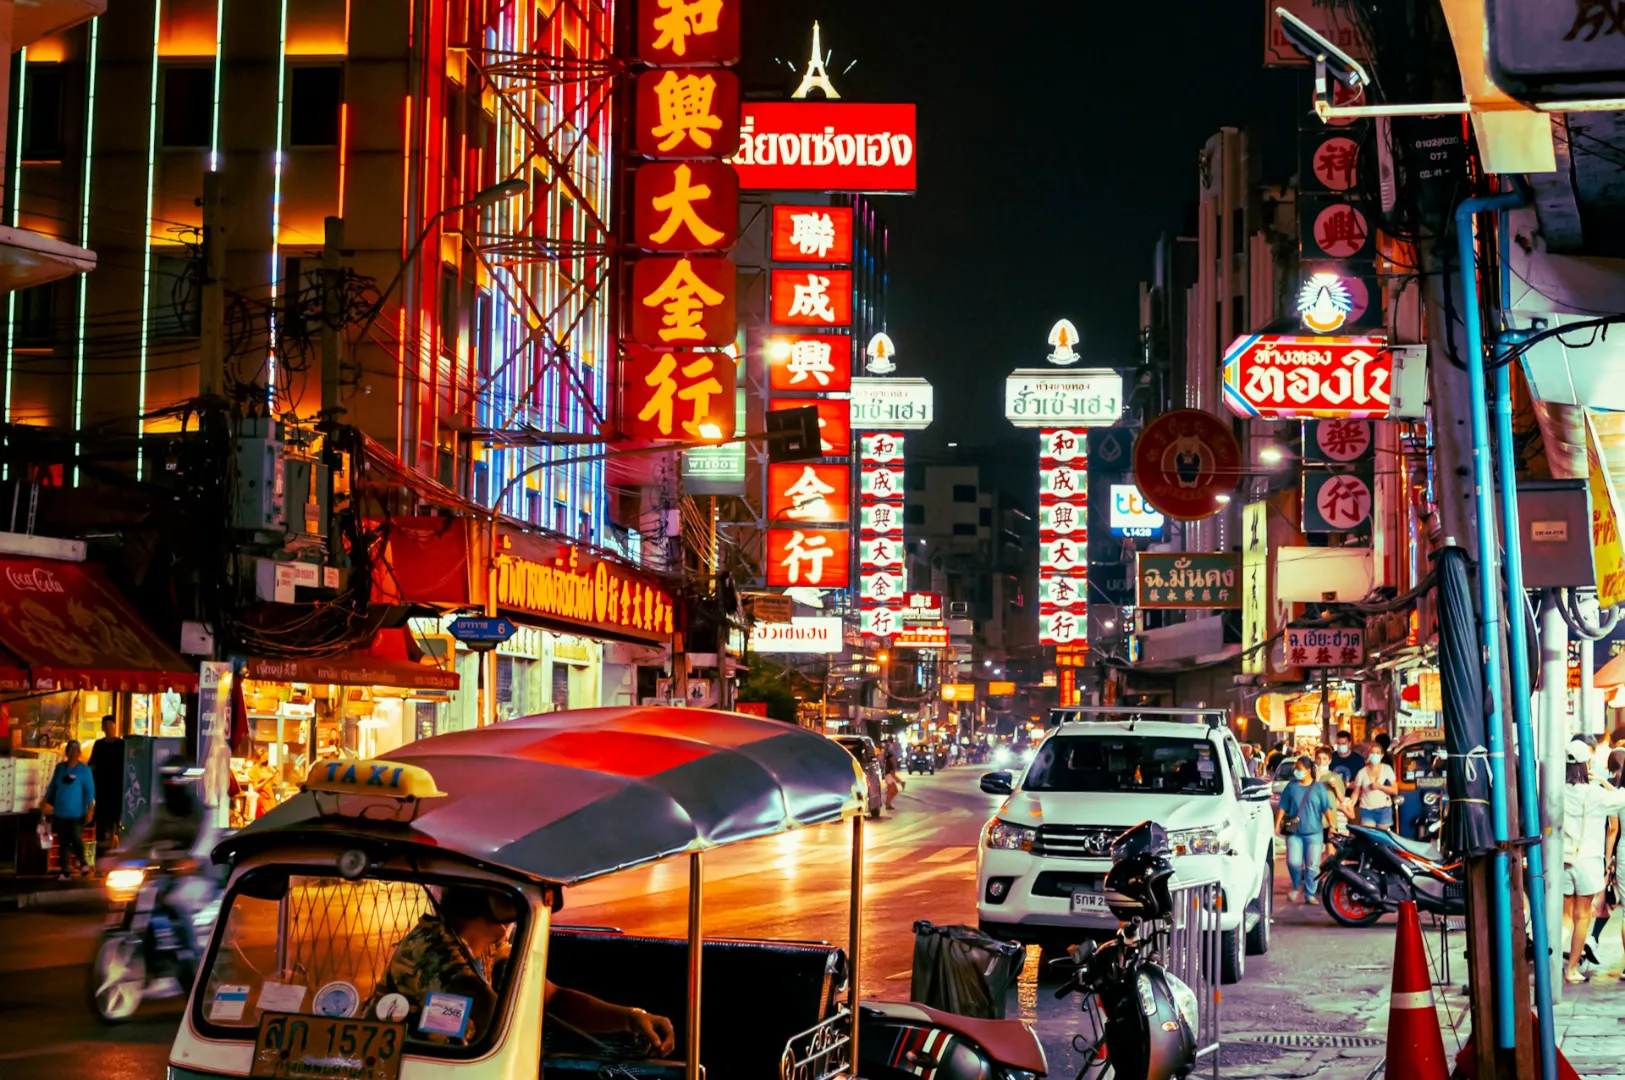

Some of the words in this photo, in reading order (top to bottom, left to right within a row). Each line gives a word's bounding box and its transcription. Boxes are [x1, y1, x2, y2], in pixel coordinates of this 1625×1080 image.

[721, 115, 914, 167] ลี่ยงเซ่งเฮง
[1254, 343, 1333, 366] ห้างทอง
[780, 211, 836, 585] 聯成興金行
[688, 460, 739, 469] WISDOM
[6, 566, 65, 593] Coca-Cola
[1144, 557, 1235, 588] ฉ.มั่นคง
[497, 623, 506, 635] 6
[325, 762, 405, 788] TAXI
[326, 1023, 397, 1060] 1573
